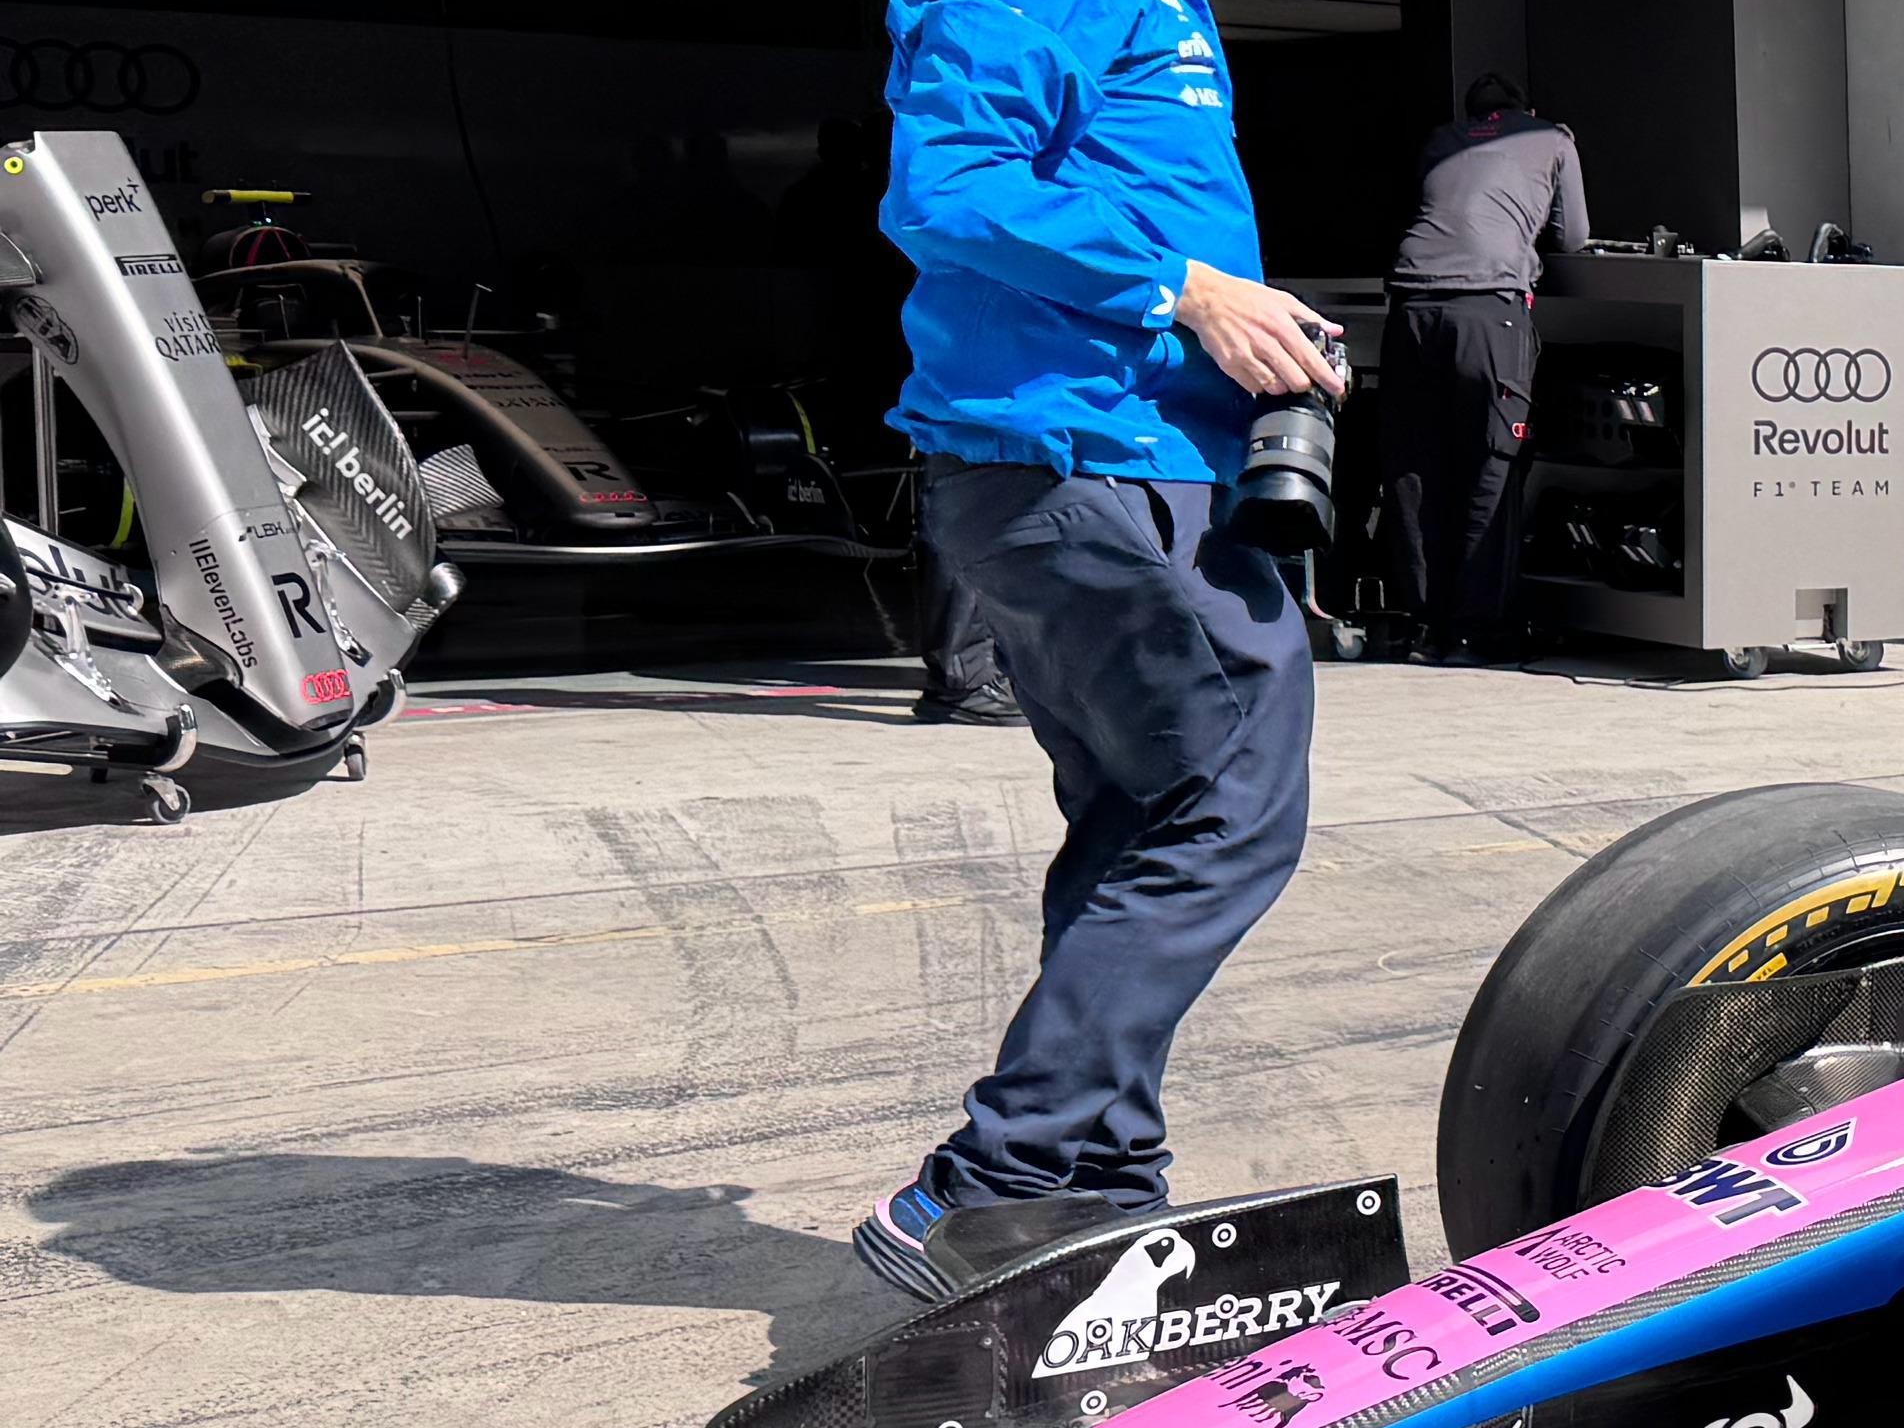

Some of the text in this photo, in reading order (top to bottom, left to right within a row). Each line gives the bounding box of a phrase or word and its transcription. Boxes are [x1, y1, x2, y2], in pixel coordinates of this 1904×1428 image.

[85, 188, 139, 220] perk
[1753, 420, 1889, 456] Revolut
[334, 446, 415, 541] berlin
[1811, 479, 1890, 498] TEAM
[1534, 1247, 1590, 1281] WOLF
[1557, 1228, 1626, 1276] ARCTIC
[1042, 1281, 1342, 1369] OAKBERRY
[1350, 1311, 1442, 1380] MSC
